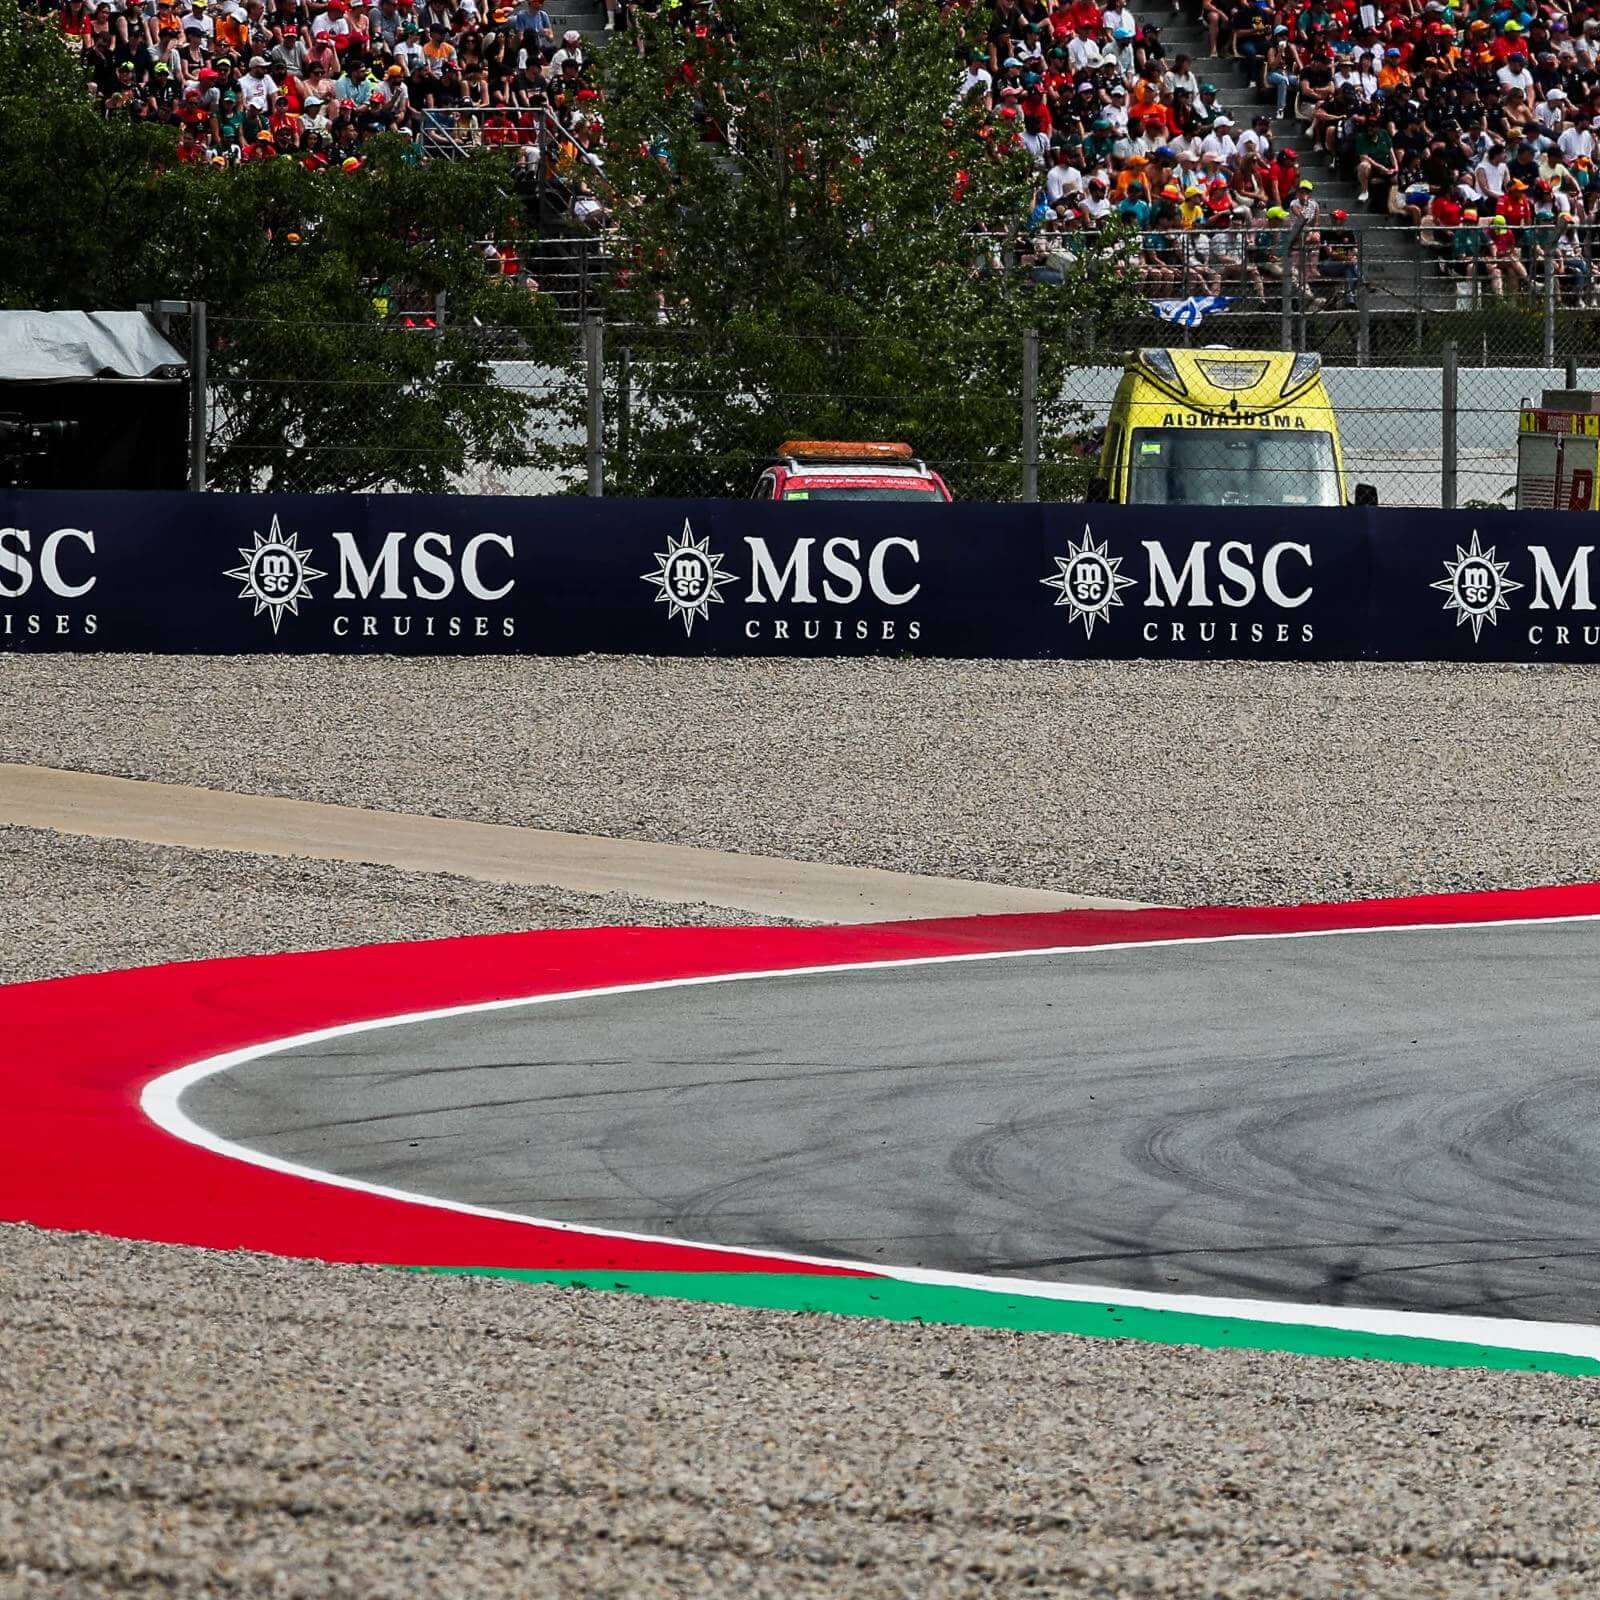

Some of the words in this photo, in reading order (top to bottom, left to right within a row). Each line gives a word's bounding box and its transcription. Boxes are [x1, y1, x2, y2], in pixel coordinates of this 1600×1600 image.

[333, 532, 514, 600] MSC
[744, 537, 920, 604] MSC
[1142, 541, 1312, 607] MSC
[334, 616, 514, 636] CRUISES
[746, 620, 920, 639] CRUISES
[1144, 623, 1313, 642] CRUISES
